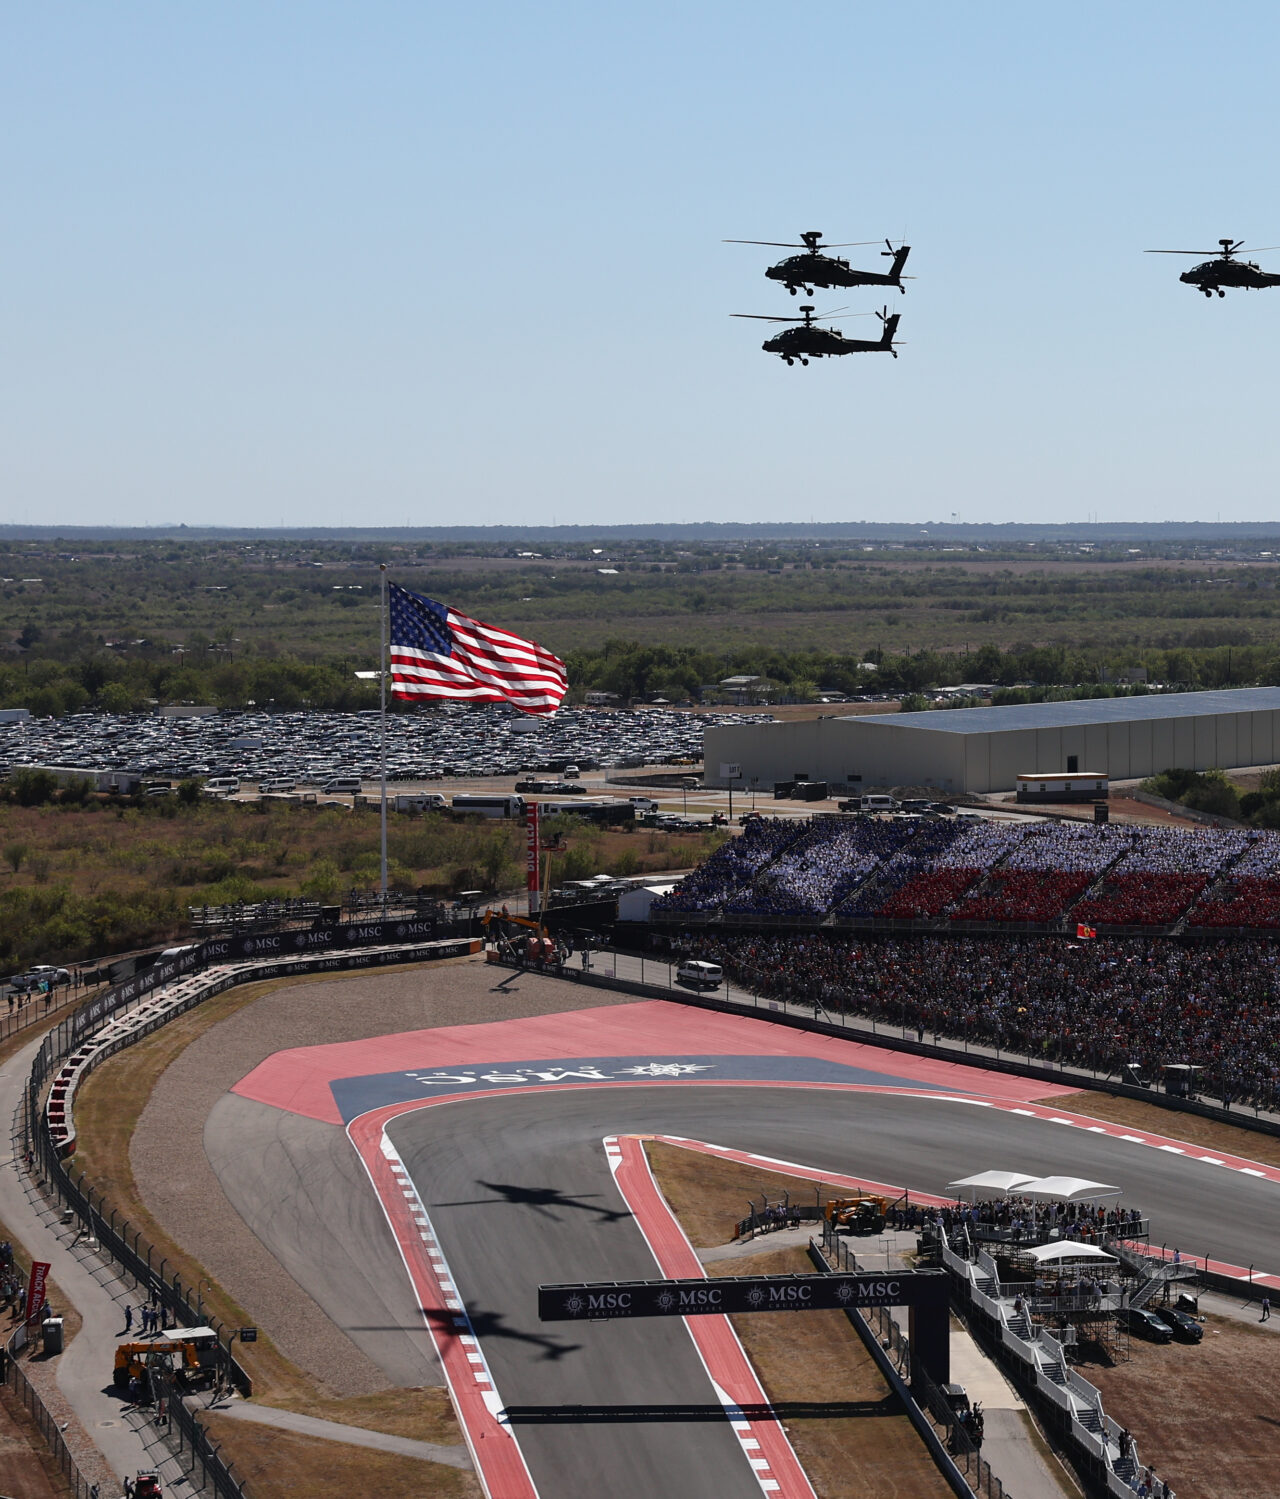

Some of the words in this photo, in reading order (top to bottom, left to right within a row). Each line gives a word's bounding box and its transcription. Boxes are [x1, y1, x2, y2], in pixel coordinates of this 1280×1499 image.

[207, 943, 229, 956] MSC
[256, 937, 280, 949] MSC
[308, 931, 332, 943] MSC
[358, 926, 382, 938] MSC
[408, 922, 431, 934] MSC
[264, 966, 278, 974] MSC
[294, 963, 310, 971] MSC
[325, 960, 340, 968] MSC
[386, 952, 400, 960] MSC
[416, 949, 430, 957] MSC
[416, 1069, 615, 1085] MSC
[34, 1265, 46, 1292] TRACK
[587, 1293, 632, 1309] MSC
[679, 1289, 722, 1305] MSC
[769, 1285, 812, 1301] MSC
[858, 1281, 900, 1297] MSC
